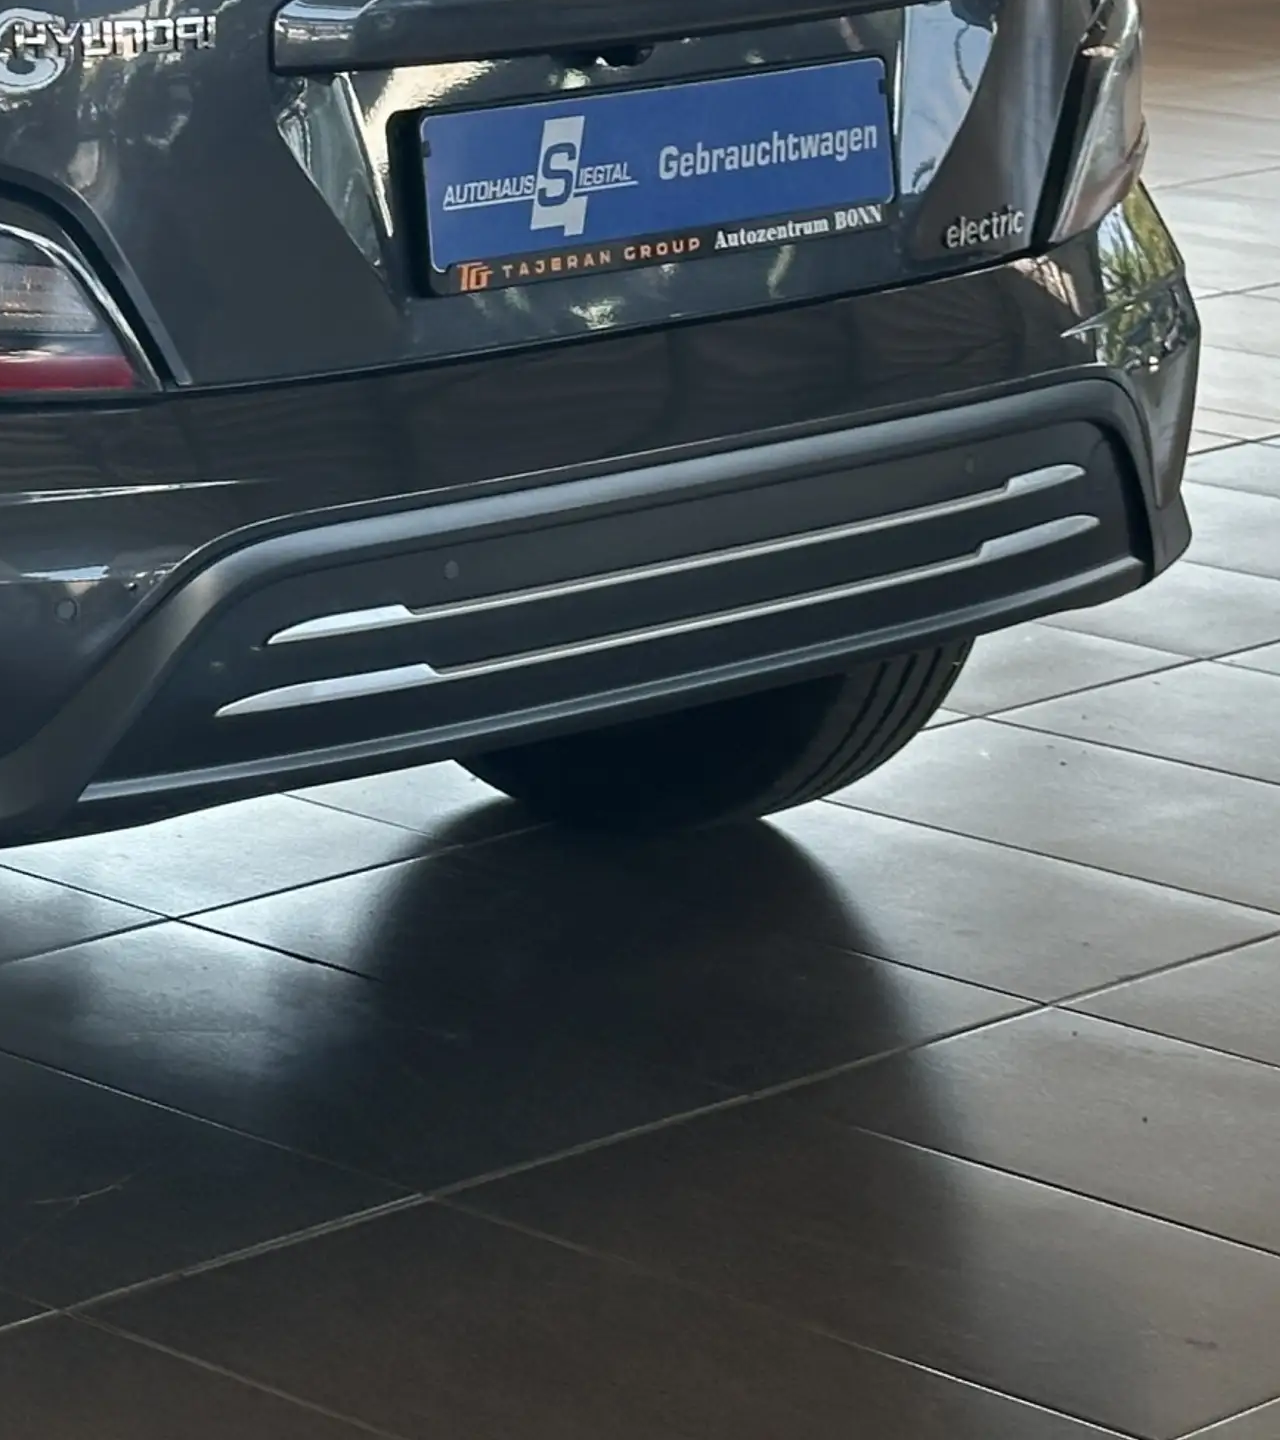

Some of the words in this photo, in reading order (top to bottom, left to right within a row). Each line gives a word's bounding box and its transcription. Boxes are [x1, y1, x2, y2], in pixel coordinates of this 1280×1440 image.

[14, 14, 217, 58] HYUNDAI
[443, 174, 536, 206] AUTOHAUS
[536, 142, 632, 208] SIEGTAL
[658, 124, 878, 181] Gebrauchtwagen
[502, 250, 611, 280] TAJERAN
[624, 237, 701, 261] GROUP
[714, 218, 830, 251] Autozentrum
[834, 203, 884, 232] BONN
[946, 204, 1025, 250] electric
